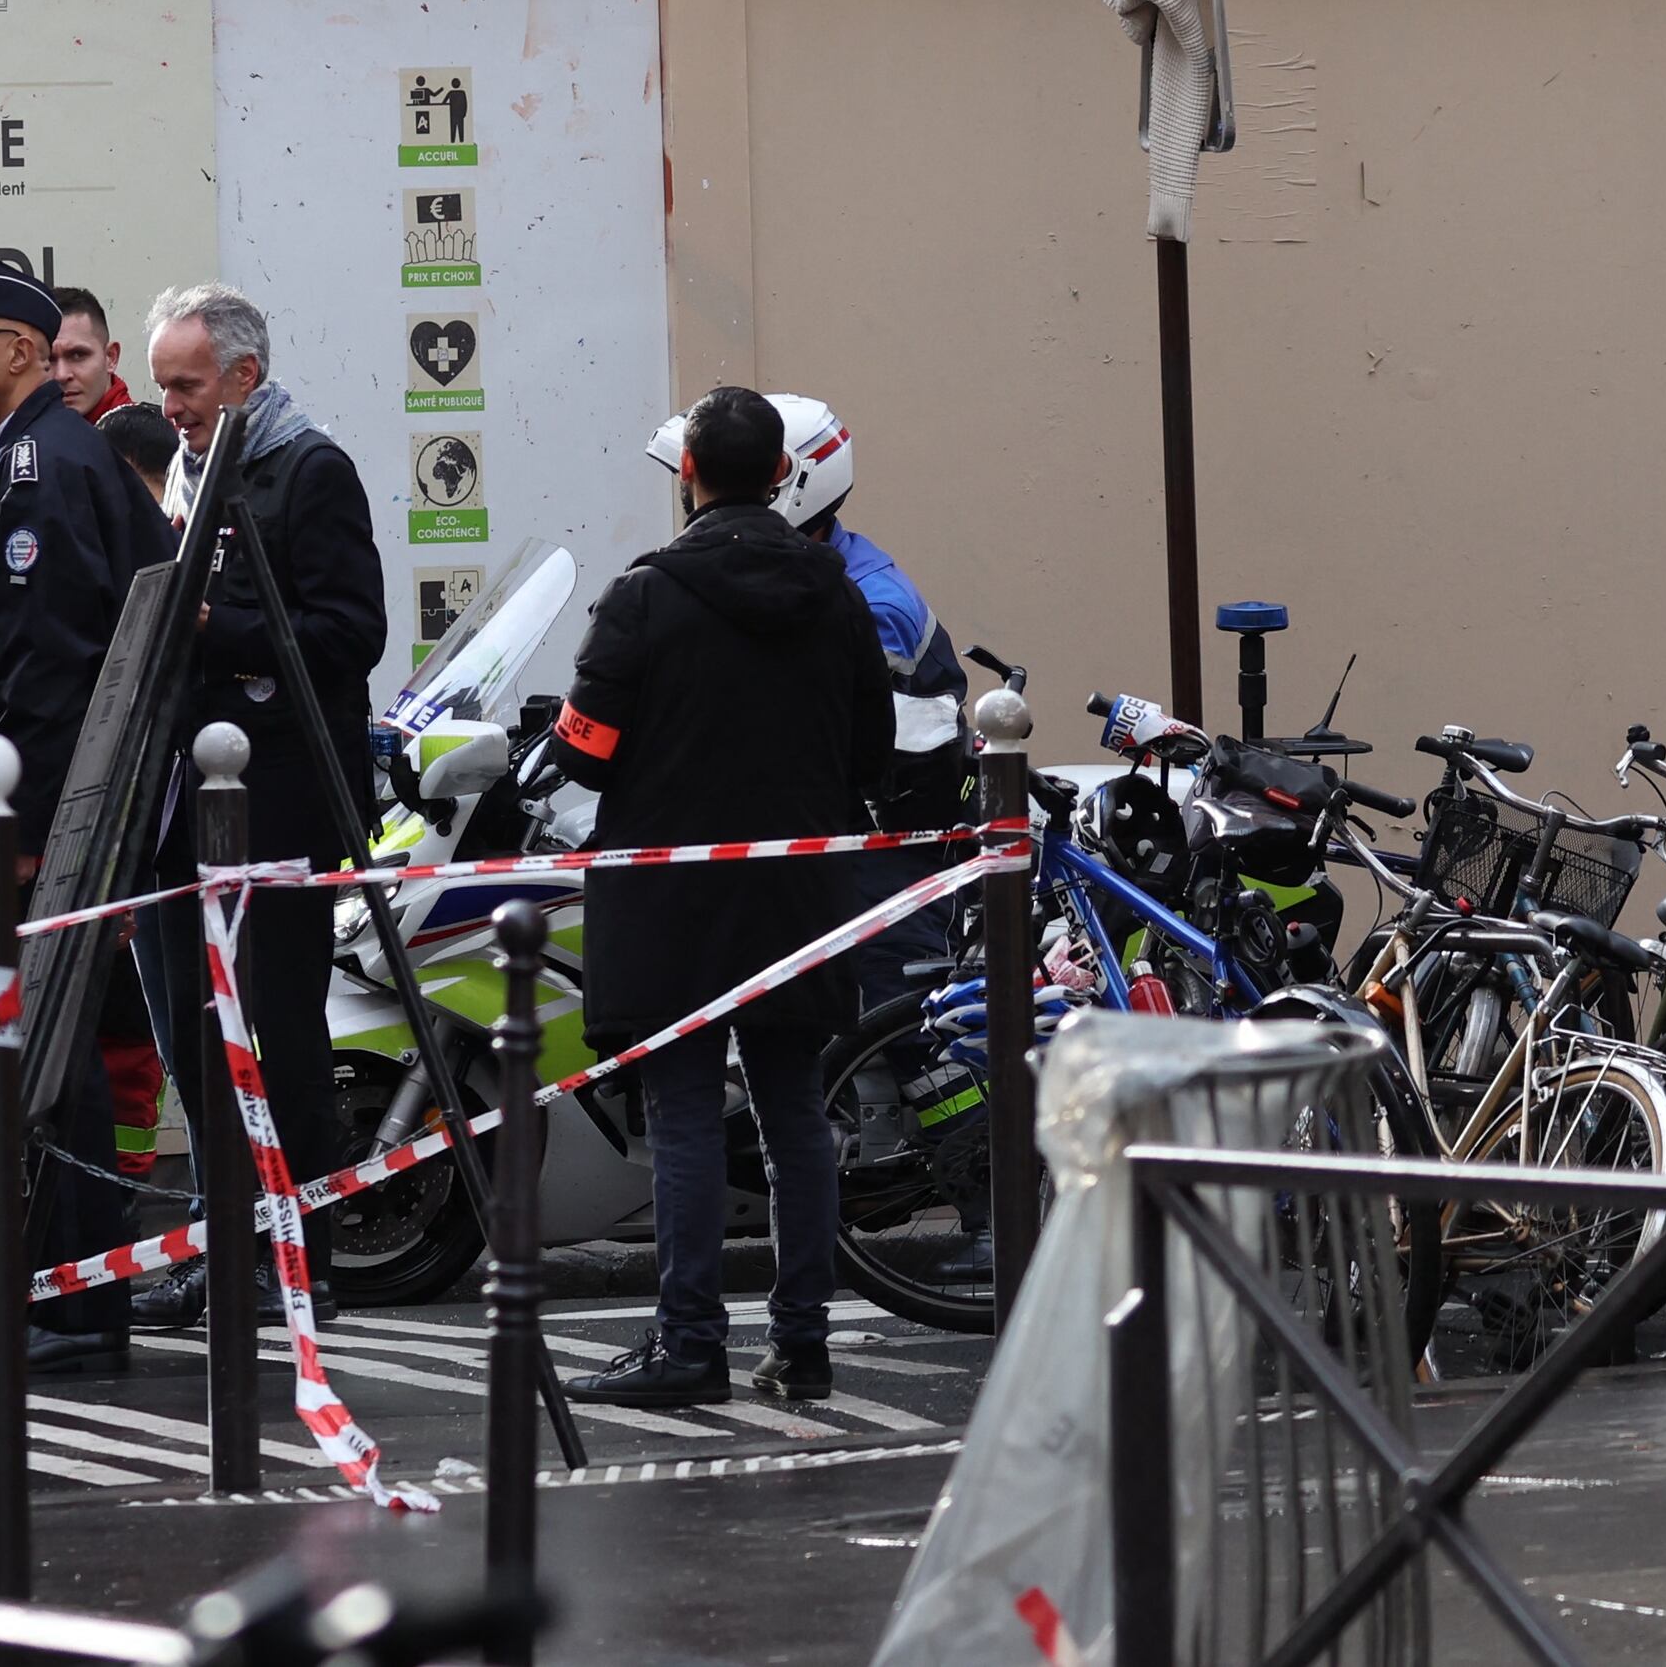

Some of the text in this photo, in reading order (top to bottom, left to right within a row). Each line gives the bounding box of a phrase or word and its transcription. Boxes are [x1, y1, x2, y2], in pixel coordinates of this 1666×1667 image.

[417, 150, 459, 163] ACCUEIL
[407, 271, 475, 283] PRIX ET CHOIX
[406, 394, 483, 408] SANTÉ PUBLIQUE
[435, 516, 461, 527] ECO-
[416, 527, 481, 540] CONSCIENCE
